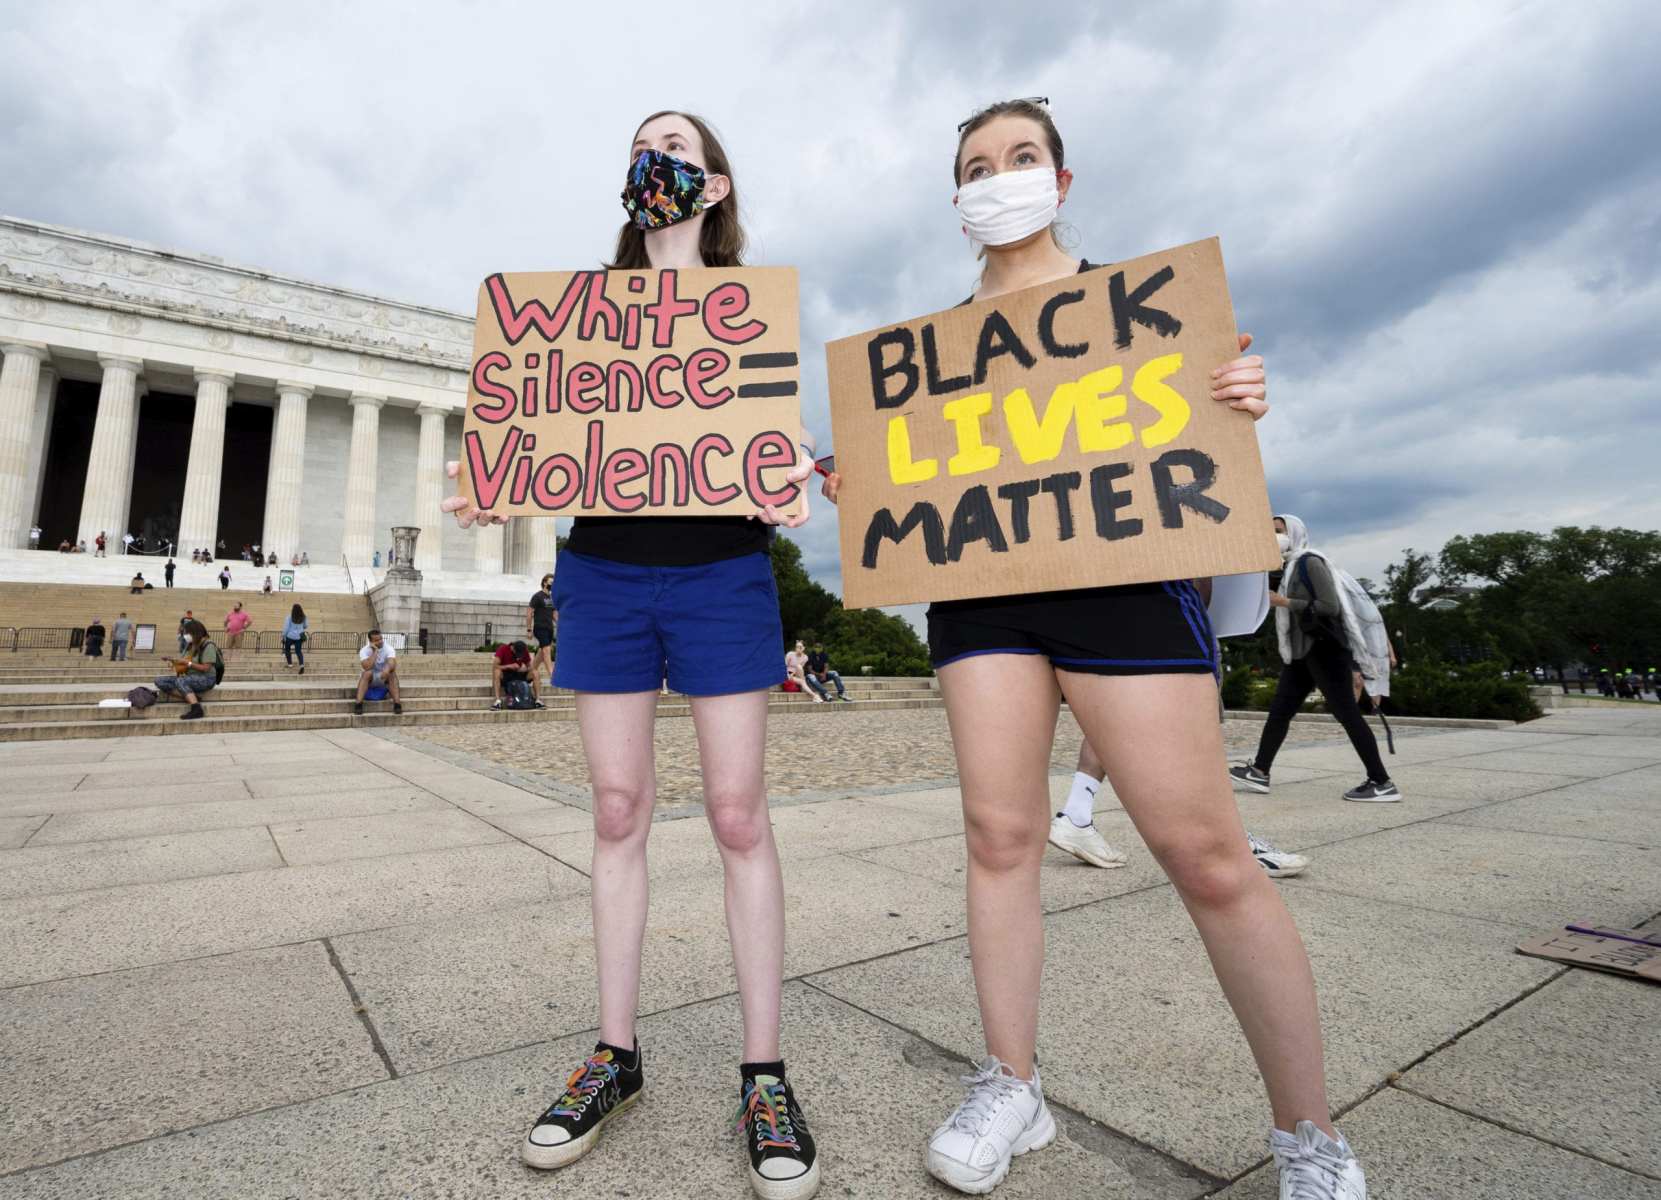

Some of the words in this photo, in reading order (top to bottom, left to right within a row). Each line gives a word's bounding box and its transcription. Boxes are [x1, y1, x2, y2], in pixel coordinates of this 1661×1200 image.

[485, 269, 768, 349] White
[868, 265, 1182, 410] BLACK
[465, 420, 800, 513] Violence
[887, 352, 1191, 485] LIVES
[861, 448, 1231, 569] MATTER
